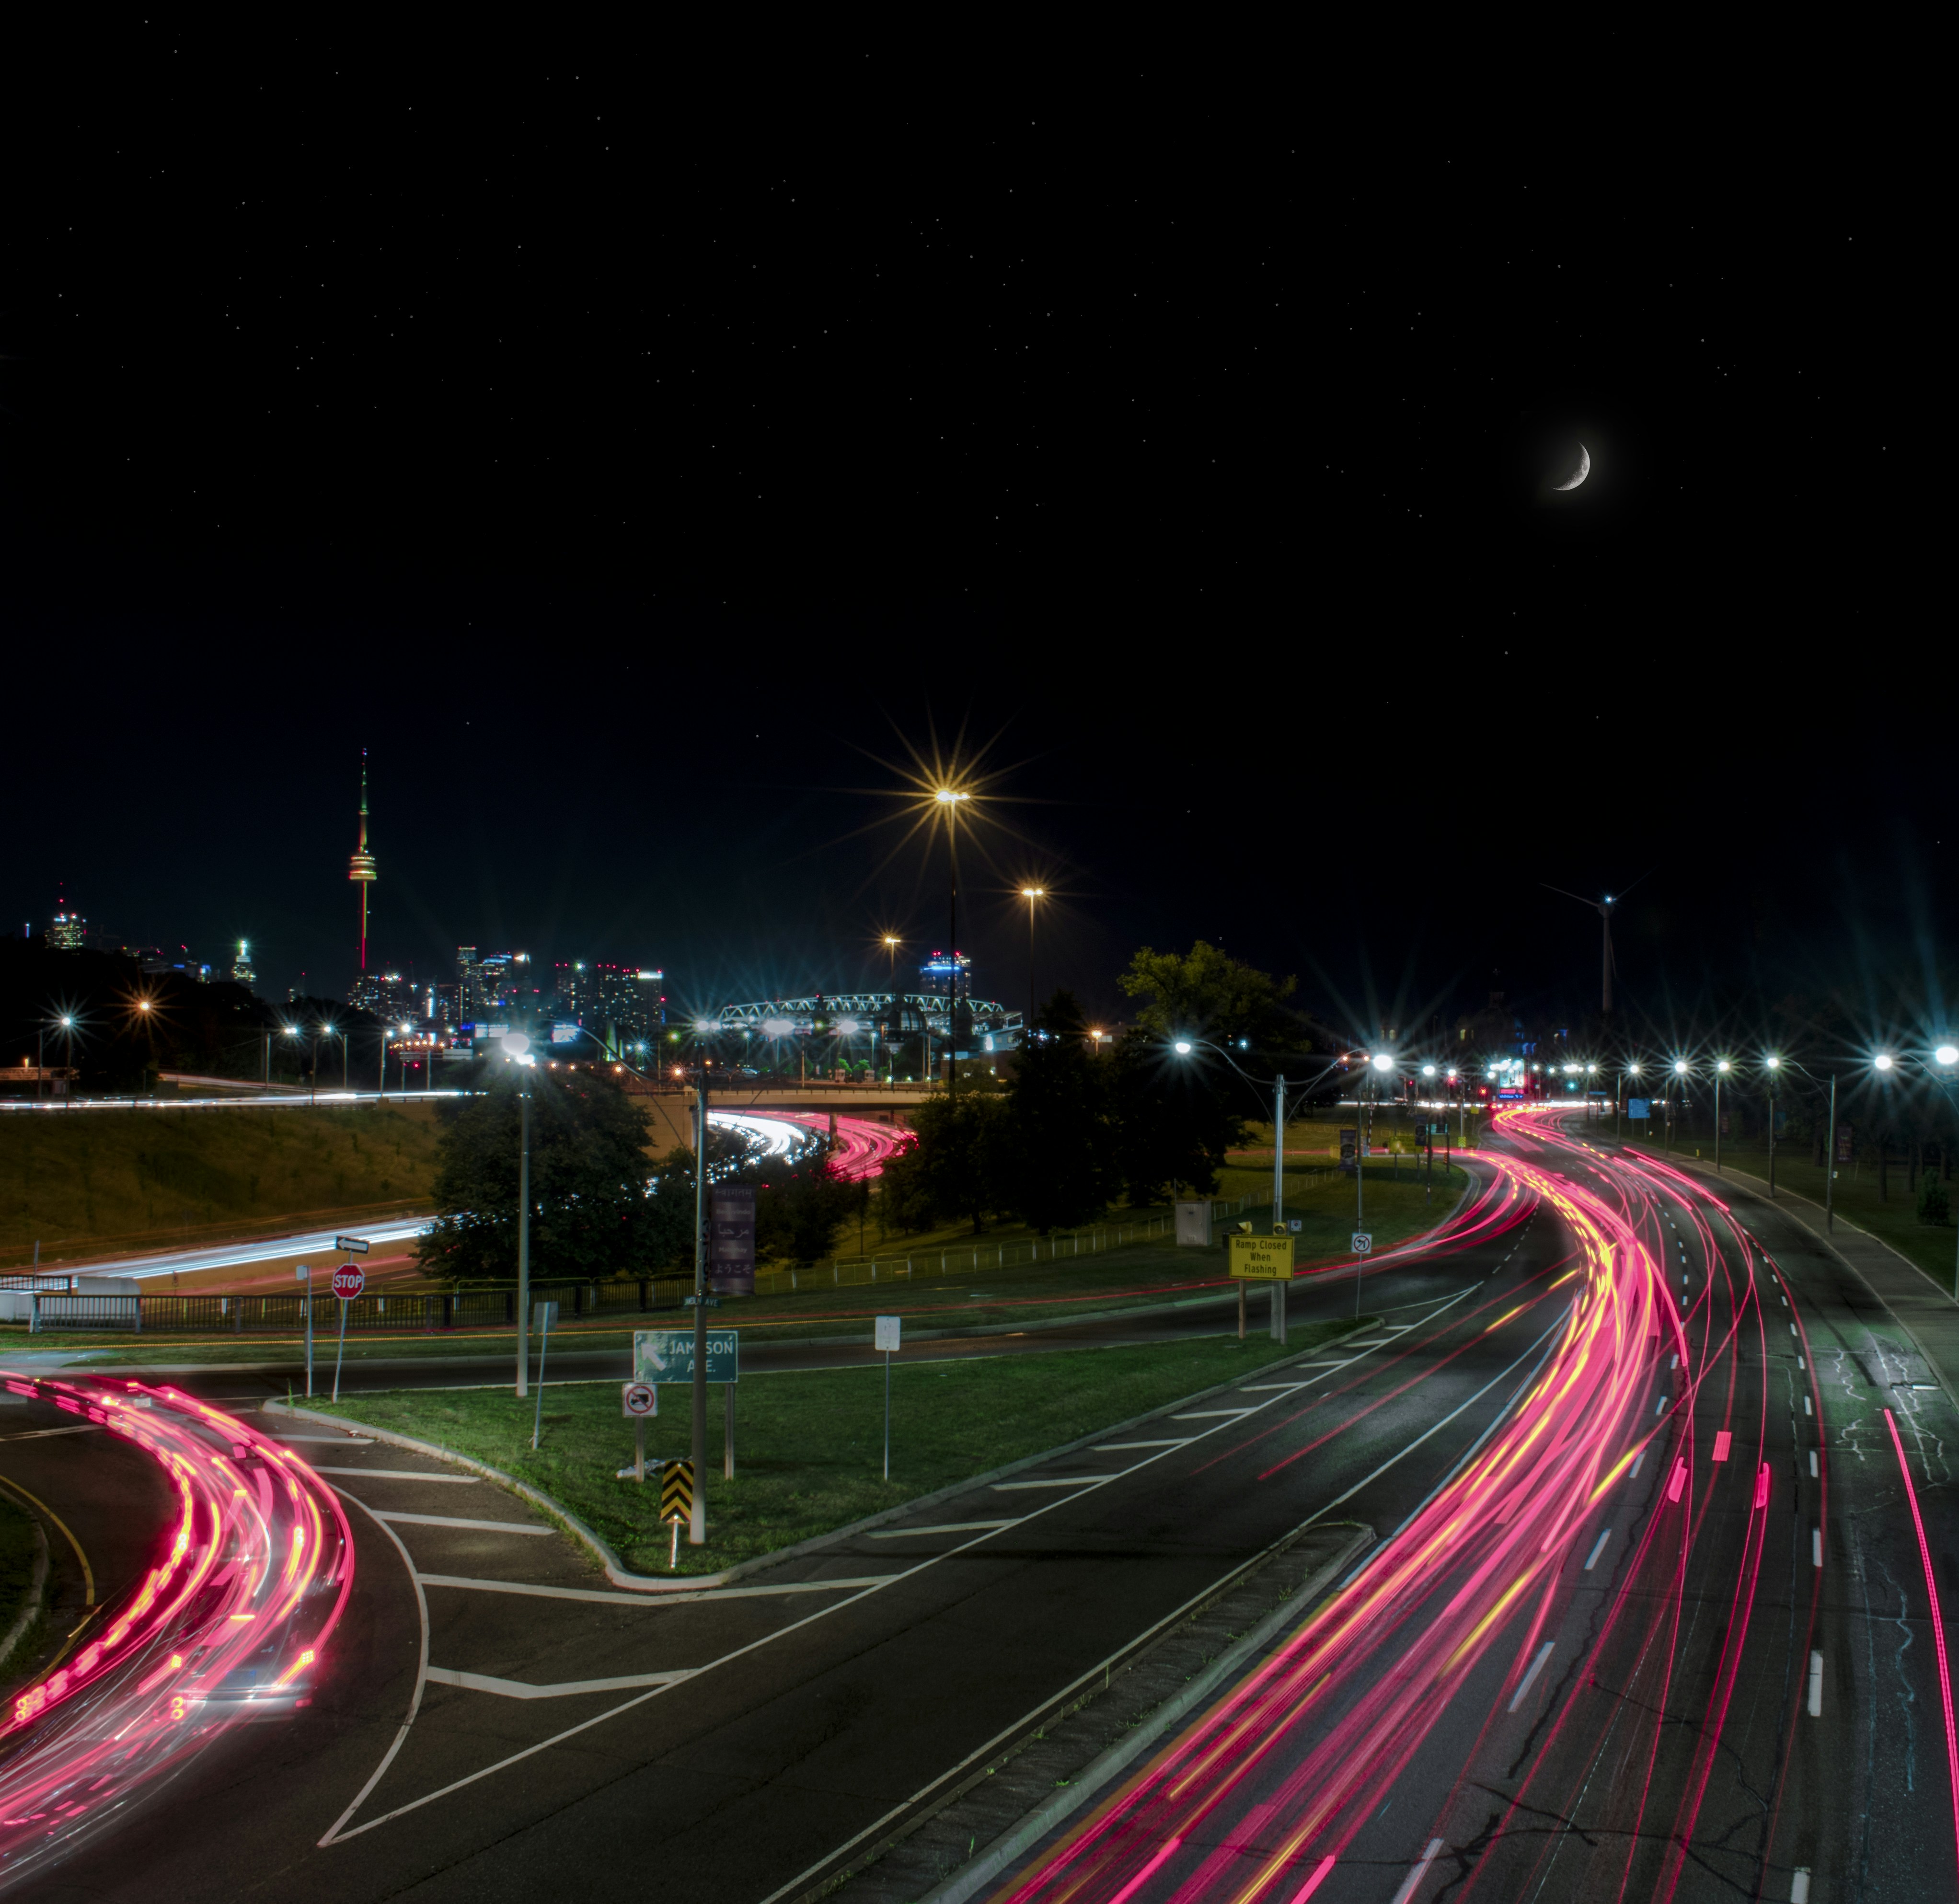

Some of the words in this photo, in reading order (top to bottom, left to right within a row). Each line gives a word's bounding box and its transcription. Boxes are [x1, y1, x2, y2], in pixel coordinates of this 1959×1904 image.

[1235, 1239, 1256, 1251] Ramp
[1260, 1240, 1287, 1250] Closed
[1250, 1252, 1271, 1261] When
[714, 1264, 752, 1274] ようこそ
[1244, 1264, 1277, 1276] Flashing
[334, 1274, 363, 1289] STOP
[669, 1341, 733, 1355] JAMSON
[686, 1359, 716, 1373] AE.
